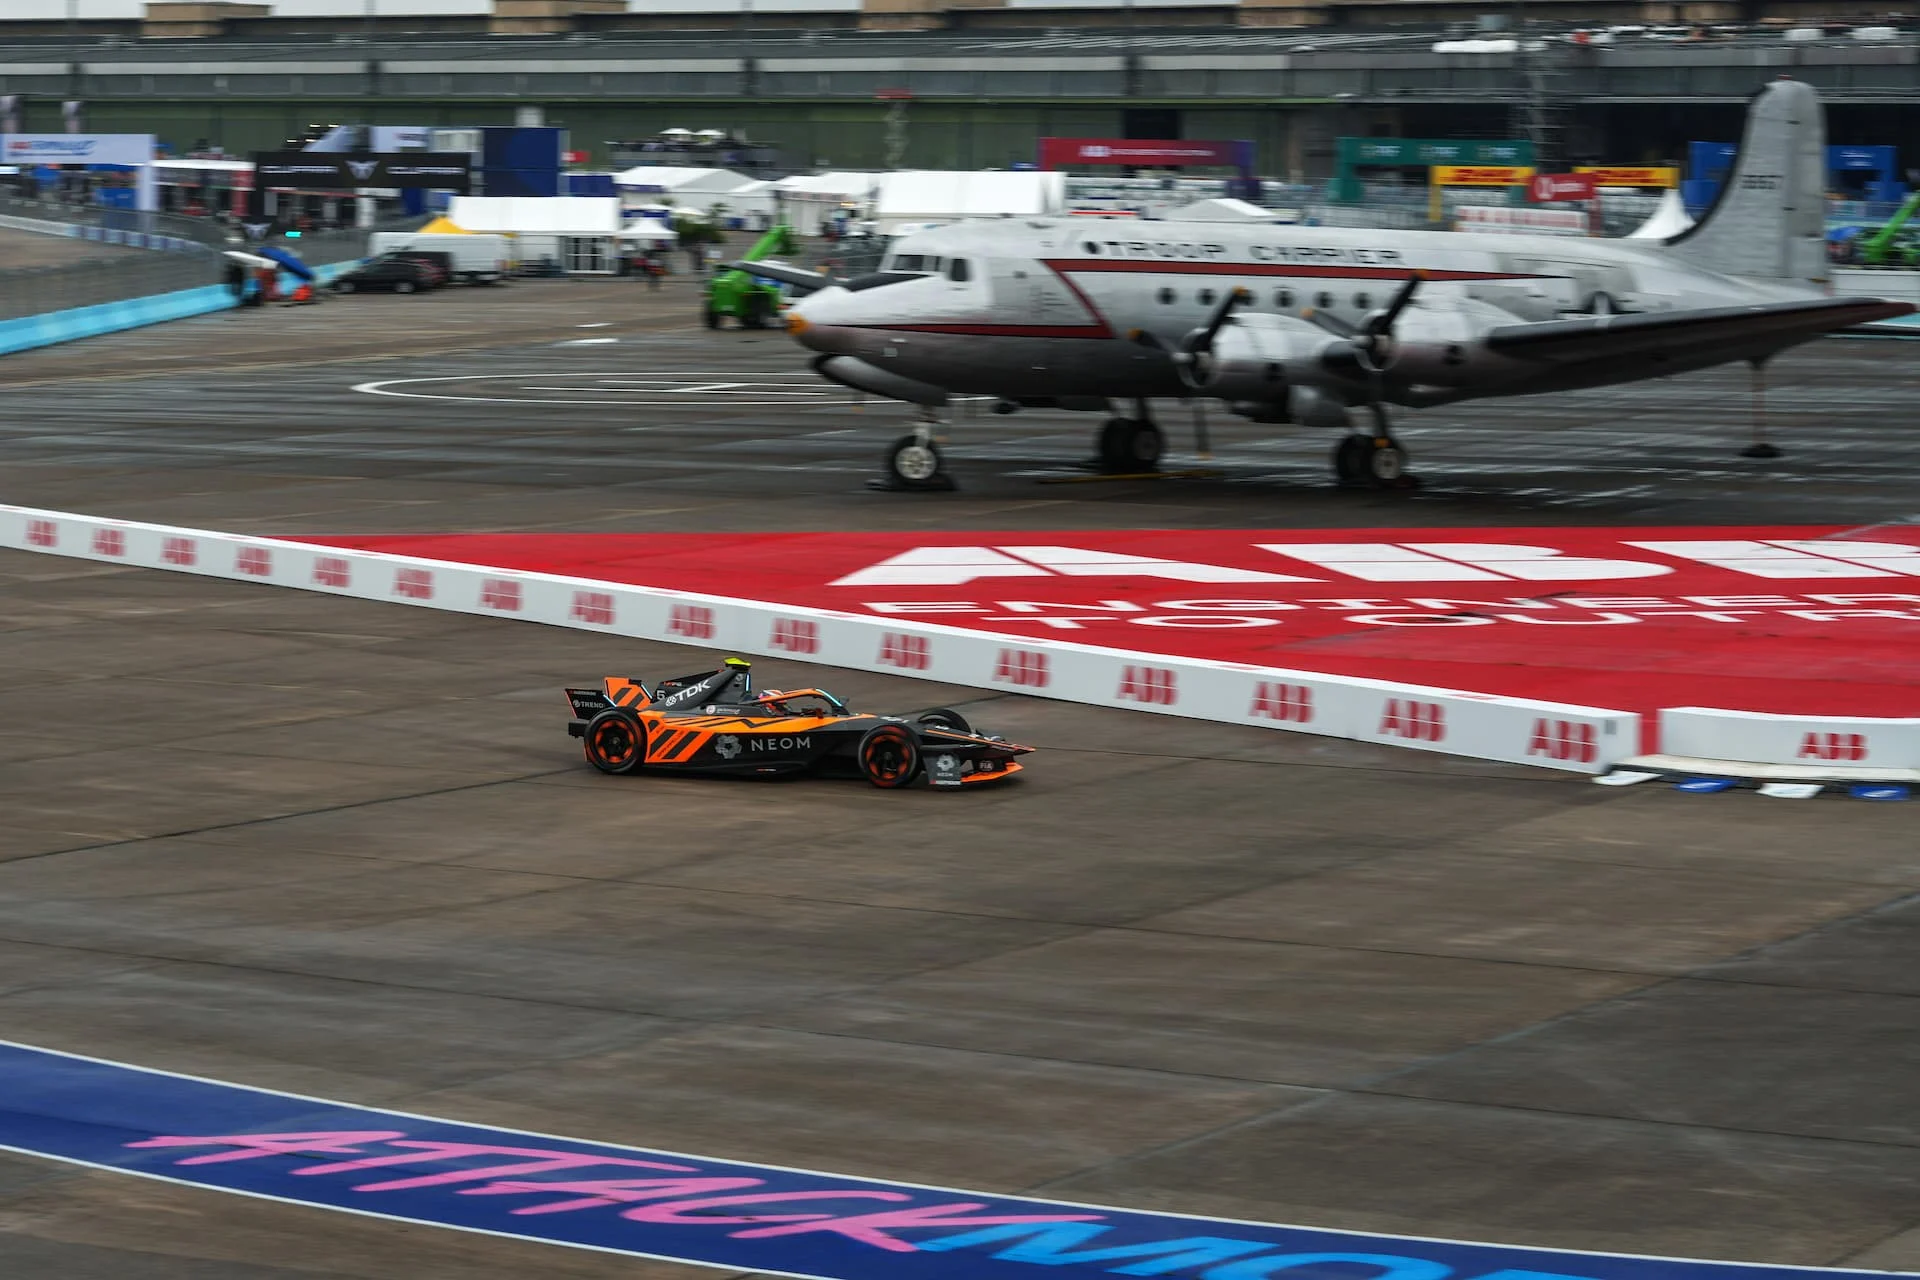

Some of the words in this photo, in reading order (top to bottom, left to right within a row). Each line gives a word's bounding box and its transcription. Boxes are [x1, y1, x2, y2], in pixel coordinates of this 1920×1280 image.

[1104, 240, 1227, 259] TROOP
[1248, 244, 1405, 265] CARRIER
[826, 540, 1920, 585] ABB
[666, 604, 717, 639] ABB
[769, 617, 822, 654] ABB
[980, 615, 1284, 628] TO
[1344, 608, 1920, 627] OUTR
[878, 631, 932, 672] ABB
[992, 647, 1050, 687] ABB
[656, 690, 666, 701] 5
[676, 680, 711, 702] TDK
[1116, 665, 1178, 705] ABB
[1249, 681, 1314, 723] ABB
[1379, 698, 1449, 742] ABB
[750, 737, 811, 752] NEOM
[1527, 717, 1600, 764] ABB
[1797, 731, 1869, 760] ABB
[124, 1130, 1107, 1252] ATTACK
